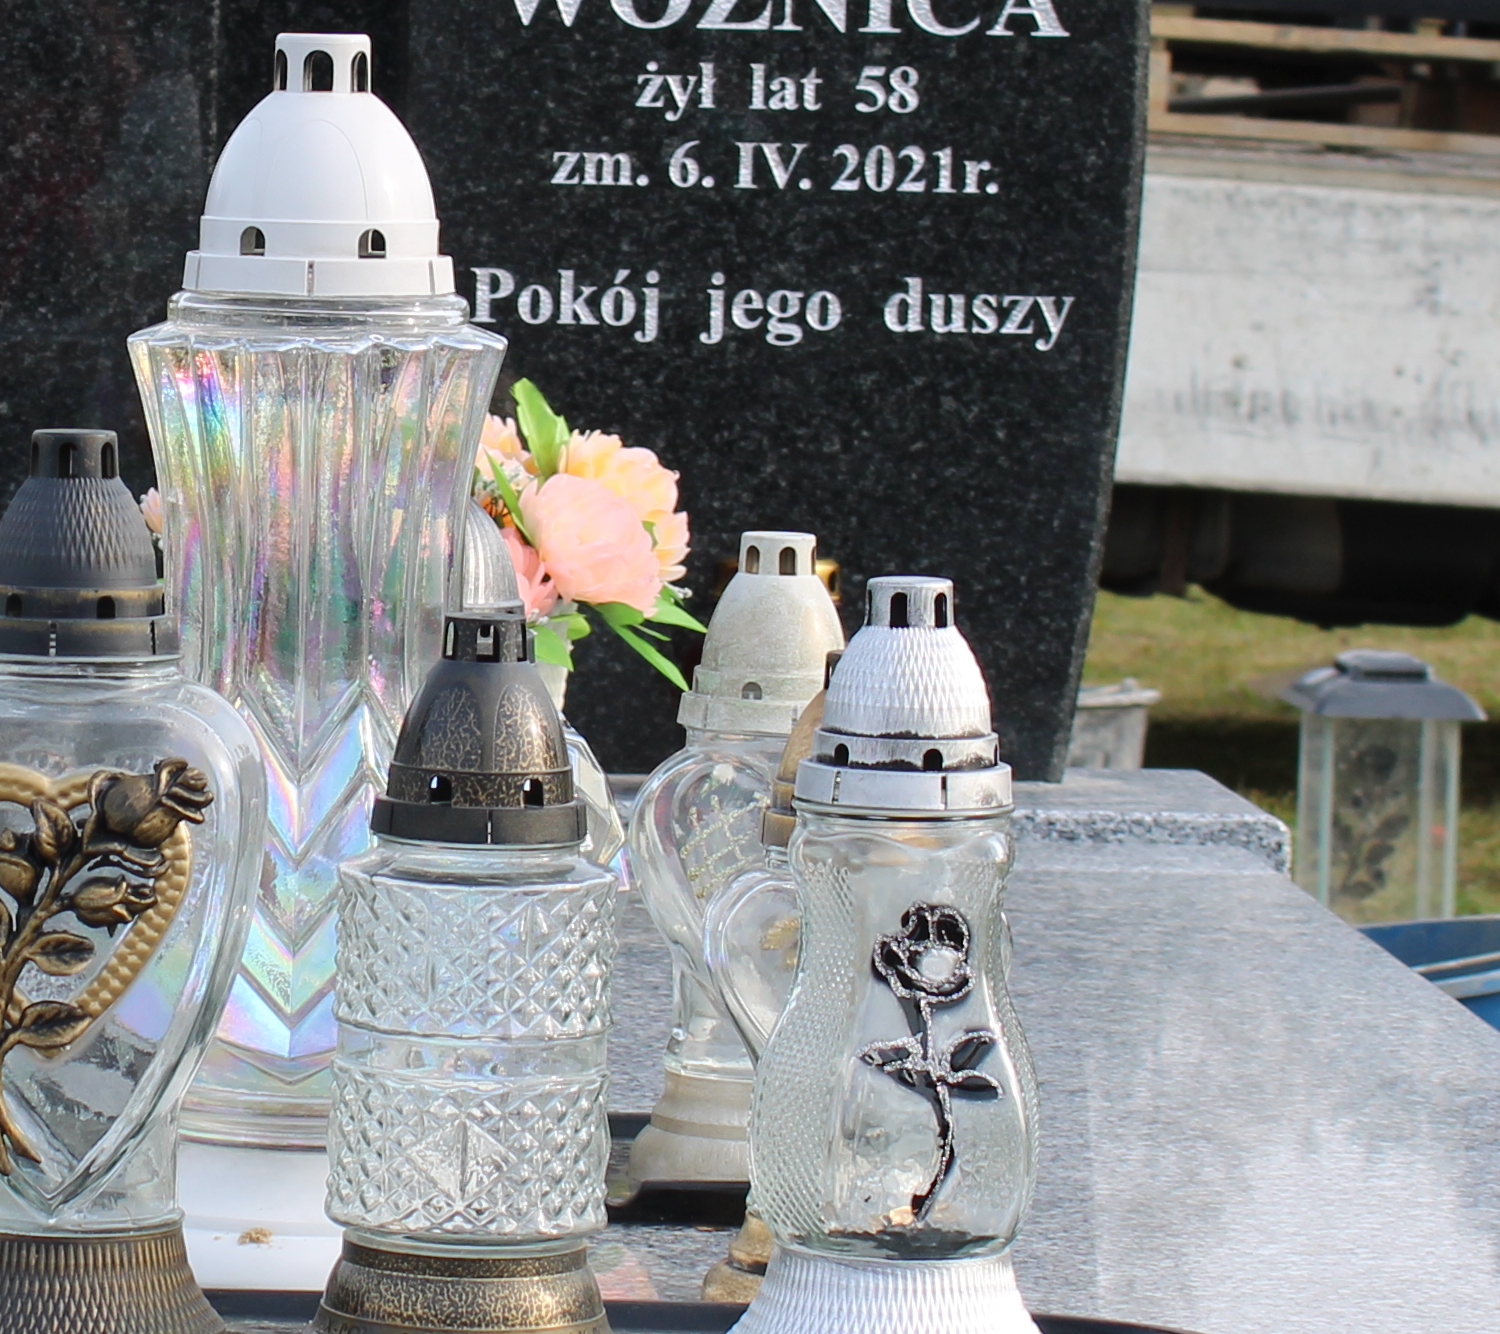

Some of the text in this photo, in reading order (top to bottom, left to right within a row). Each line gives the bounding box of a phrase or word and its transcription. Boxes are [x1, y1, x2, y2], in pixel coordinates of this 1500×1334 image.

[636, 61, 920, 122] żył lat 58
[551, 140, 999, 195] zm. 6. IV. 2021r.
[470, 267, 1075, 352] Pokój jego duszy
